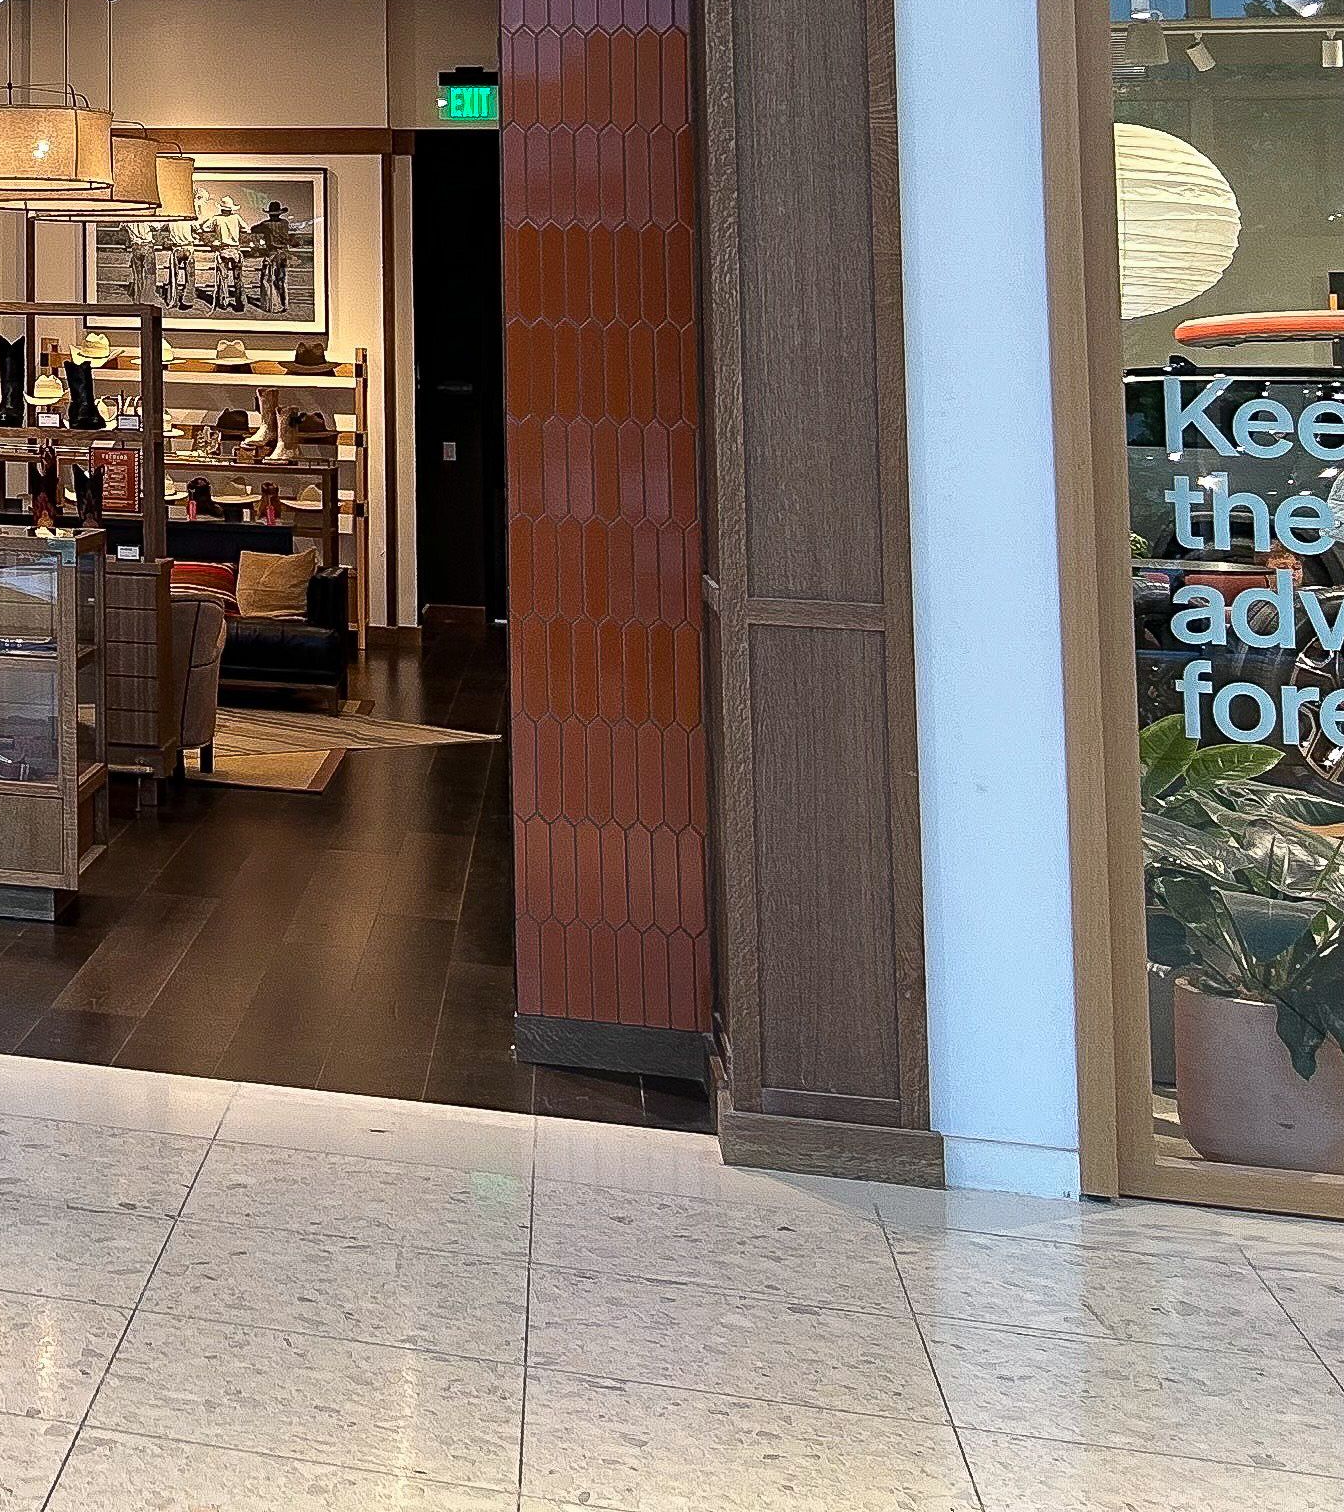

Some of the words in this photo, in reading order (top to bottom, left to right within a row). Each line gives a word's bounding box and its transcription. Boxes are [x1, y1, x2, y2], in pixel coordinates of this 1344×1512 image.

[450, 87, 491, 118] EXIT
[1163, 376, 1344, 460] Kee
[1164, 472, 1335, 556] the
[1170, 569, 1344, 651] adv
